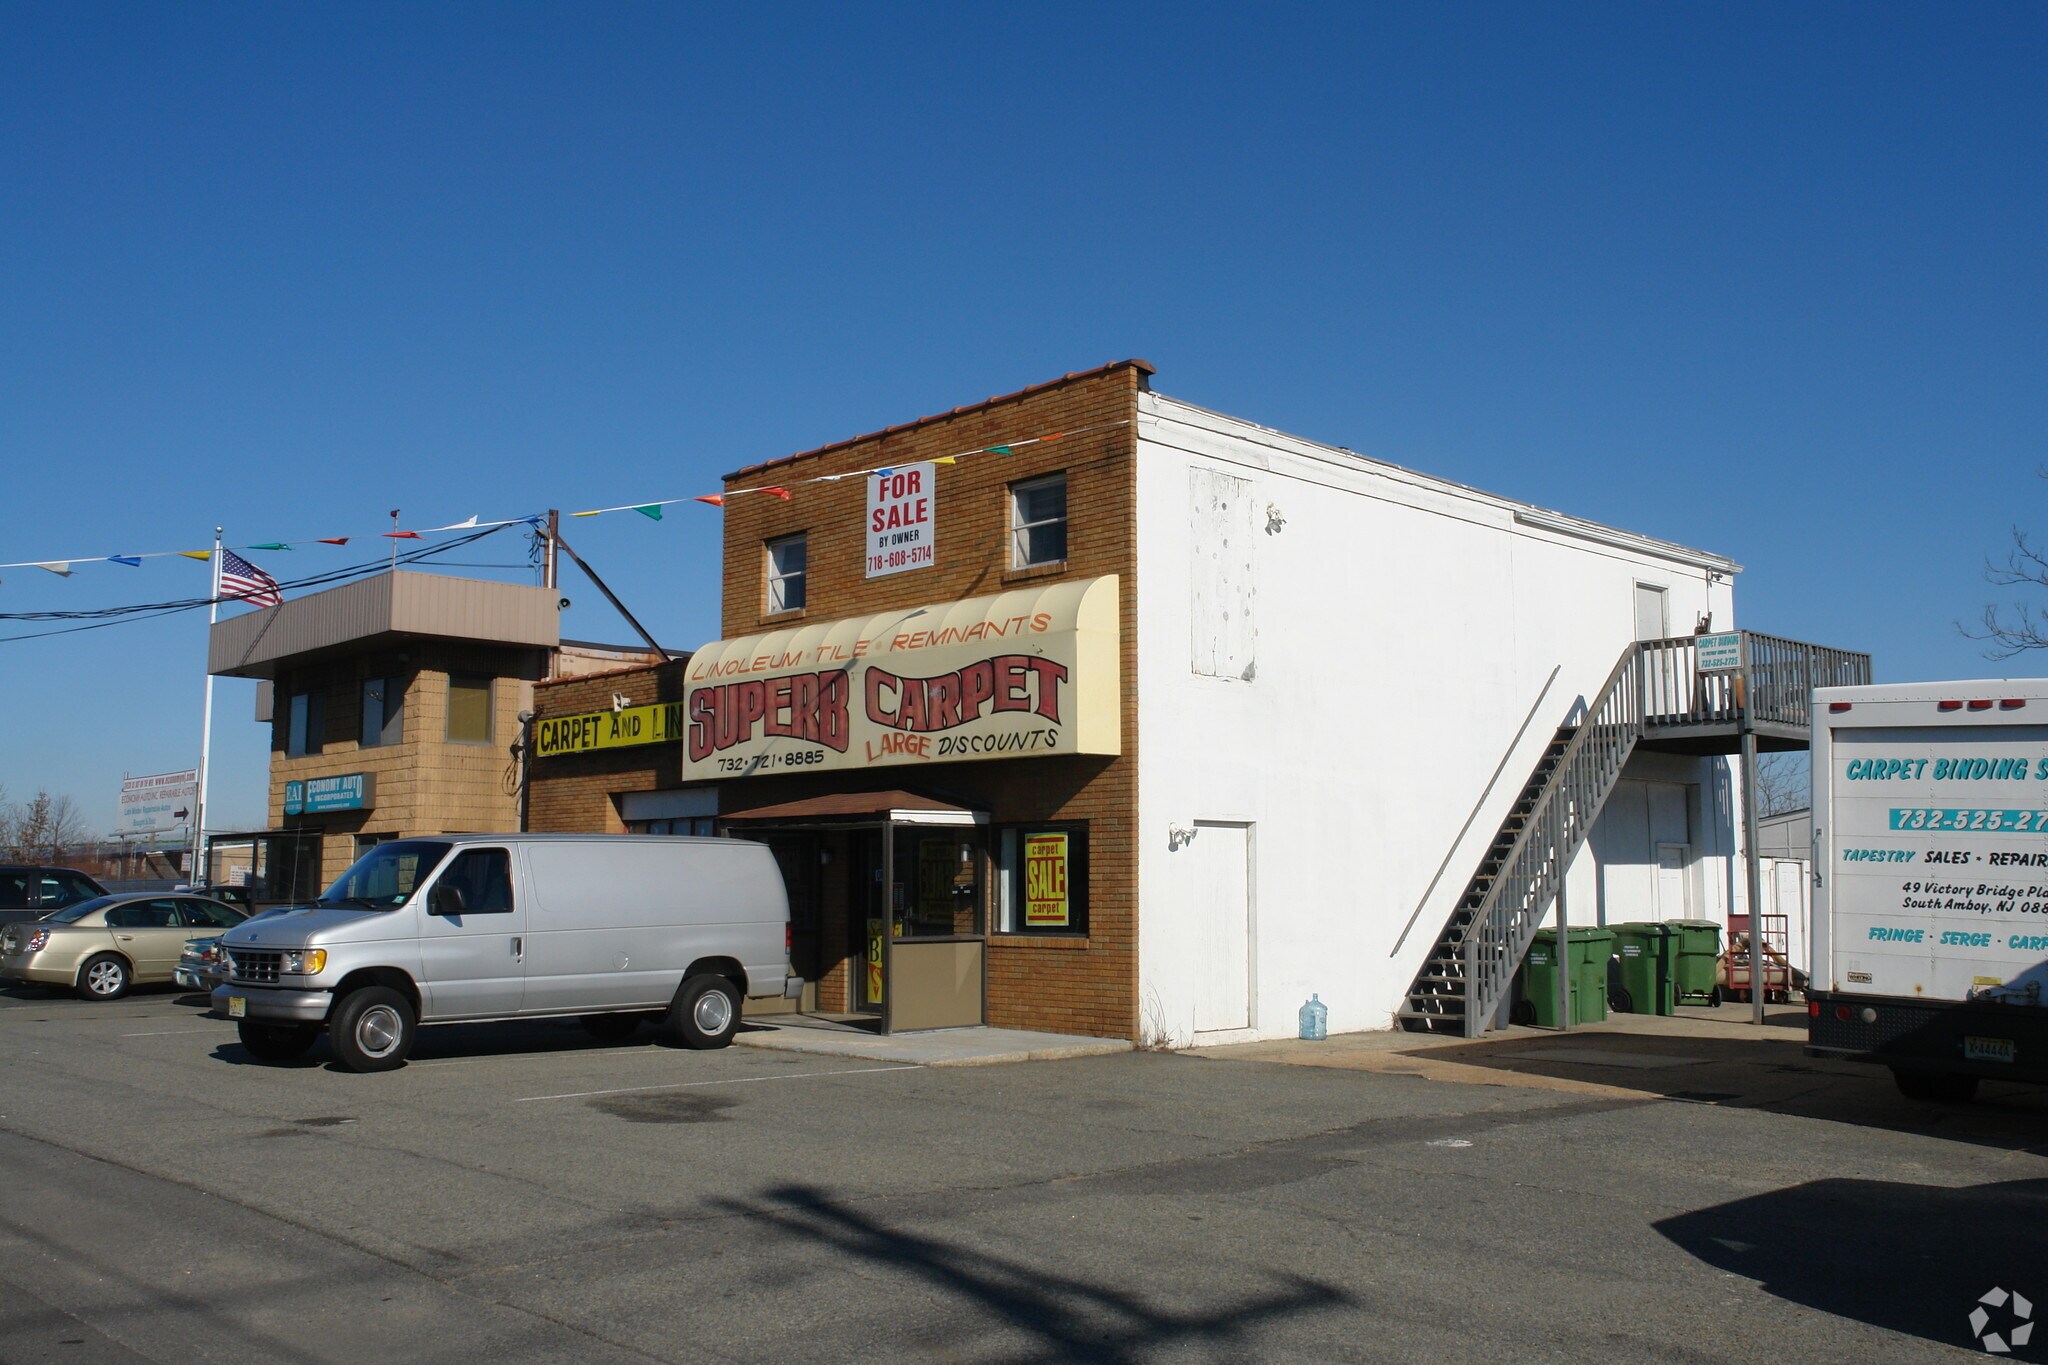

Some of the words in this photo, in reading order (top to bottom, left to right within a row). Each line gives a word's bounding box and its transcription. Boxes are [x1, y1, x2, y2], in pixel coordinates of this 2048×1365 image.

[879, 470, 921, 502] FOR
[872, 498, 928, 533] SALE
[879, 535, 889, 548] BY
[892, 529, 919, 545] OWNER
[868, 545, 931, 572] 718-608-5714
[691, 650, 803, 681] LINOLEUM
[816, 640, 870, 661] TILE
[890, 613, 1051, 651] REMNANTS
[1699, 637, 1718, 648] CARPET
[1718, 634, 1738, 646] BINDING
[1702, 656, 1738, 668] 732-525-2725
[865, 654, 1068, 732] CARPET
[688, 669, 850, 763] SUPERB
[540, 716, 602, 752] CARPET
[610, 716, 641, 739] AND
[866, 732, 932, 763] LARGE
[938, 728, 1059, 756] DISCOUNTS
[1846, 758, 1928, 780] CARPET
[1932, 758, 2028, 780] BINDING
[286, 785, 302, 802] EAI
[308, 778, 340, 802] ECONOMY
[343, 776, 362, 798] AUTO
[315, 792, 353, 801] INCORPORATED
[1032, 843, 1058, 856] carpet
[1842, 849, 1916, 862] TAPESTRY
[1924, 851, 1971, 864] SALES
[1989, 852, 2048, 867] REPAIR
[1028, 860, 1064, 900] SALE
[1902, 882, 1921, 893] 49
[1924, 882, 1974, 898] Victory
[1976, 884, 2024, 900] Bridge
[1032, 902, 1059, 914] carpet
[1902, 897, 1942, 909] South
[1944, 899, 1992, 914] Amboy,
[1996, 901, 2015, 912] NJ
[1868, 927, 1925, 943] FRINGE
[1940, 931, 1992, 947] SERGE
